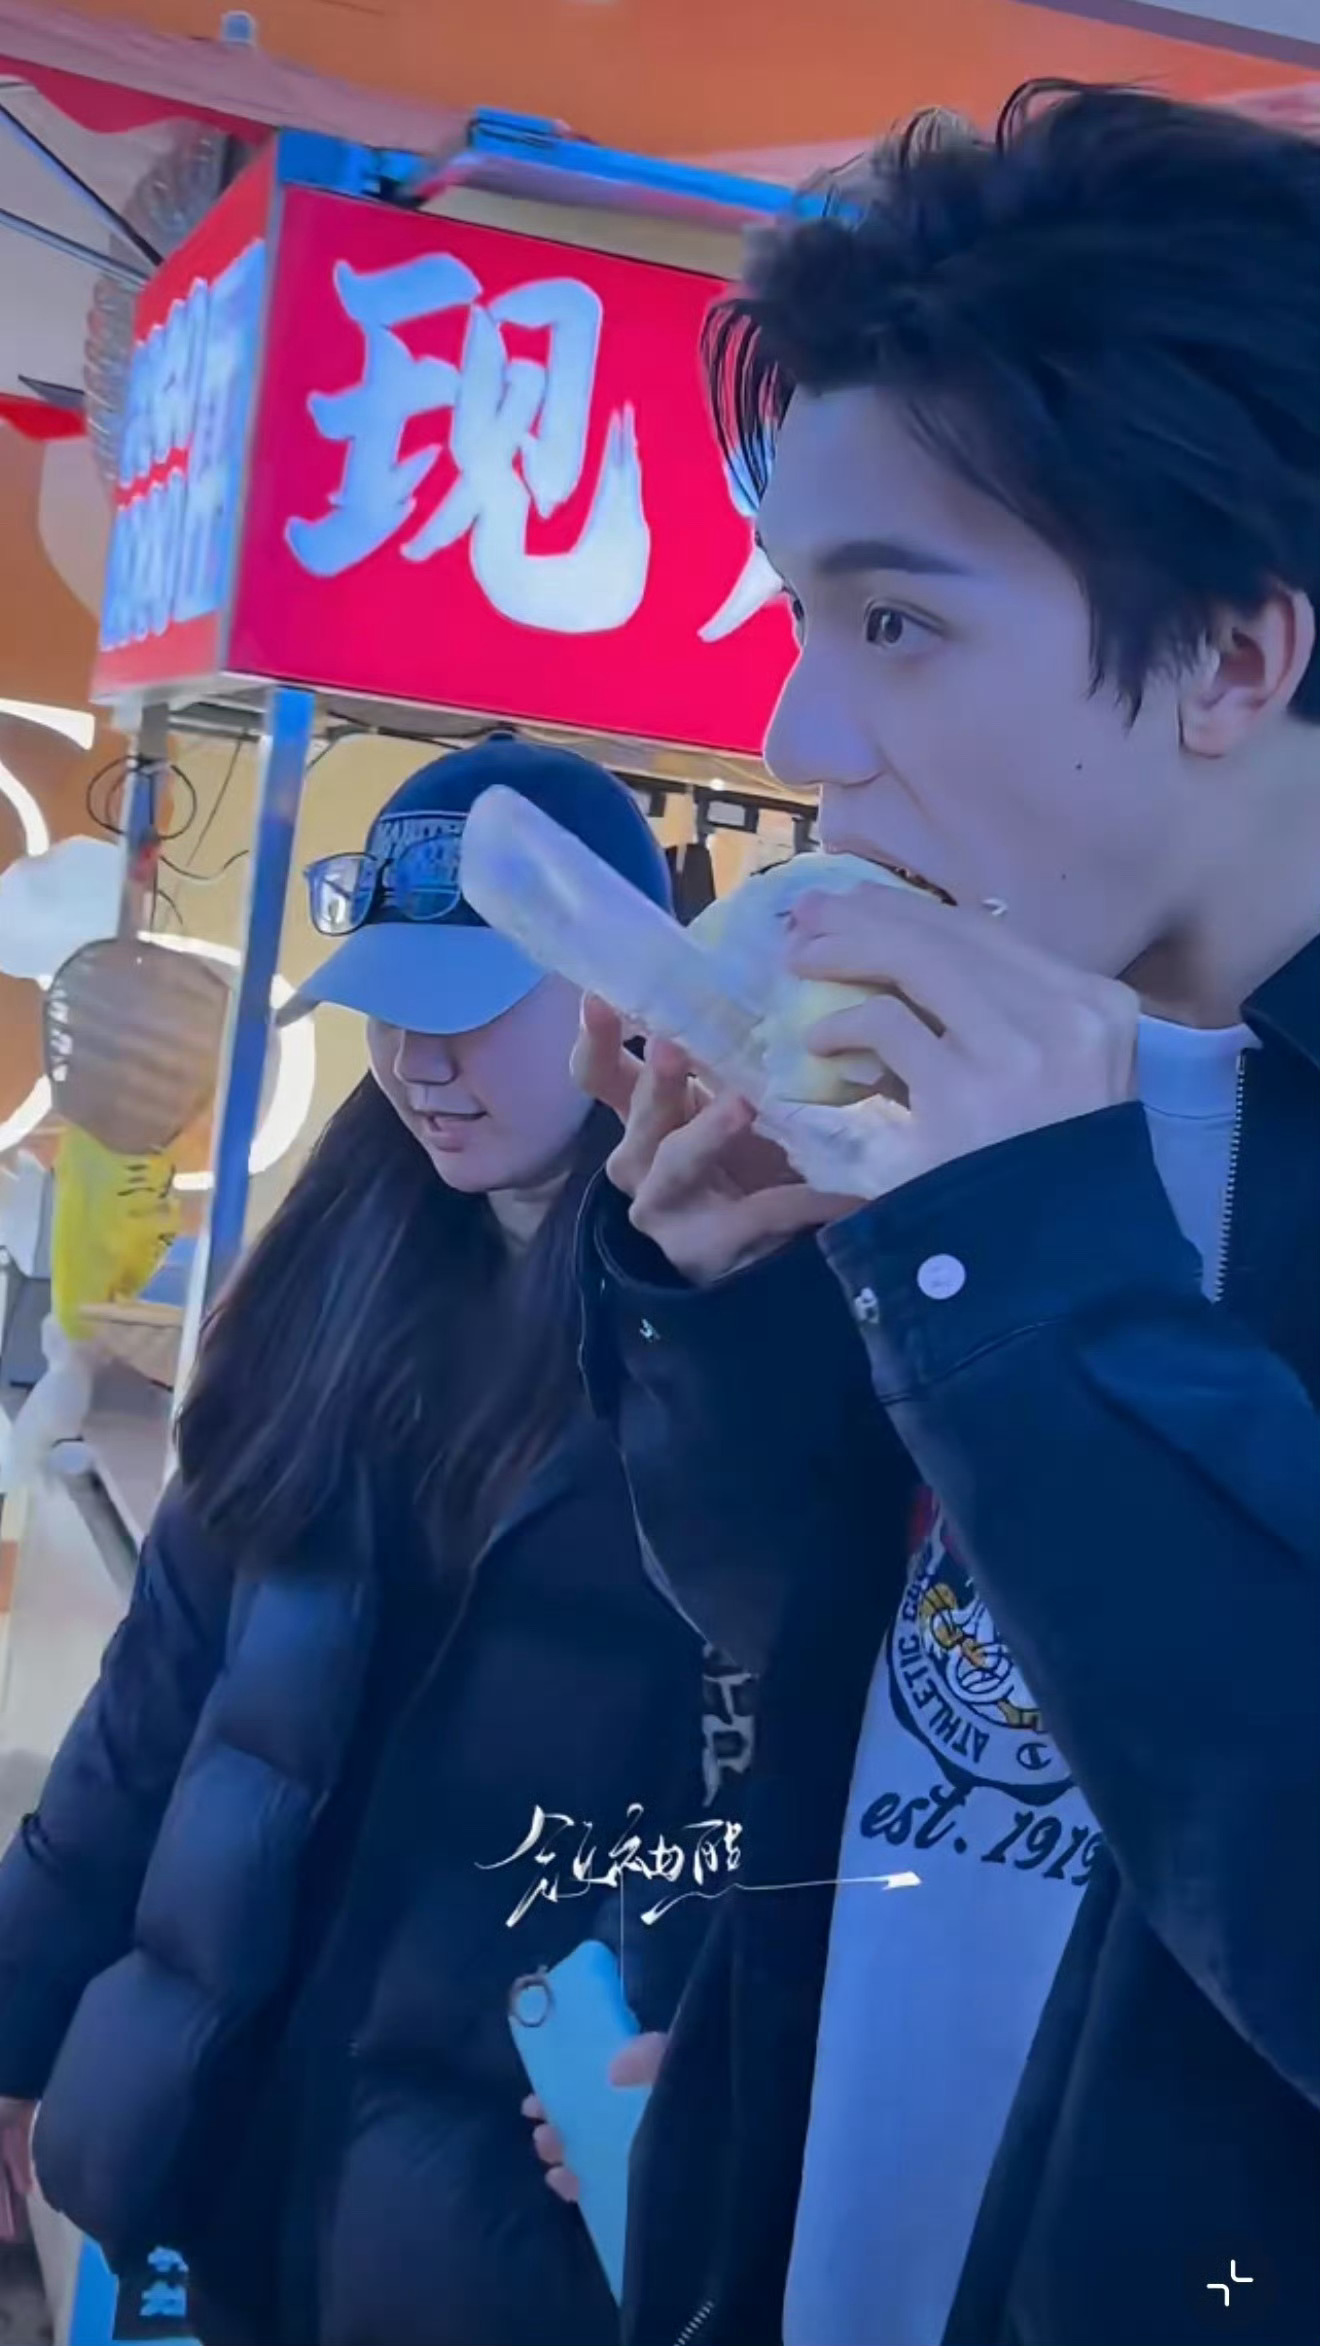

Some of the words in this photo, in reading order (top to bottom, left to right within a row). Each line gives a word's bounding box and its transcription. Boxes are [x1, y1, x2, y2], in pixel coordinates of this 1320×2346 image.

[284, 253, 790, 643] 现
[897, 1633, 990, 1764] ATHLETIC
[860, 1785, 968, 1856] est.
[980, 1811, 1102, 1886] 1919
